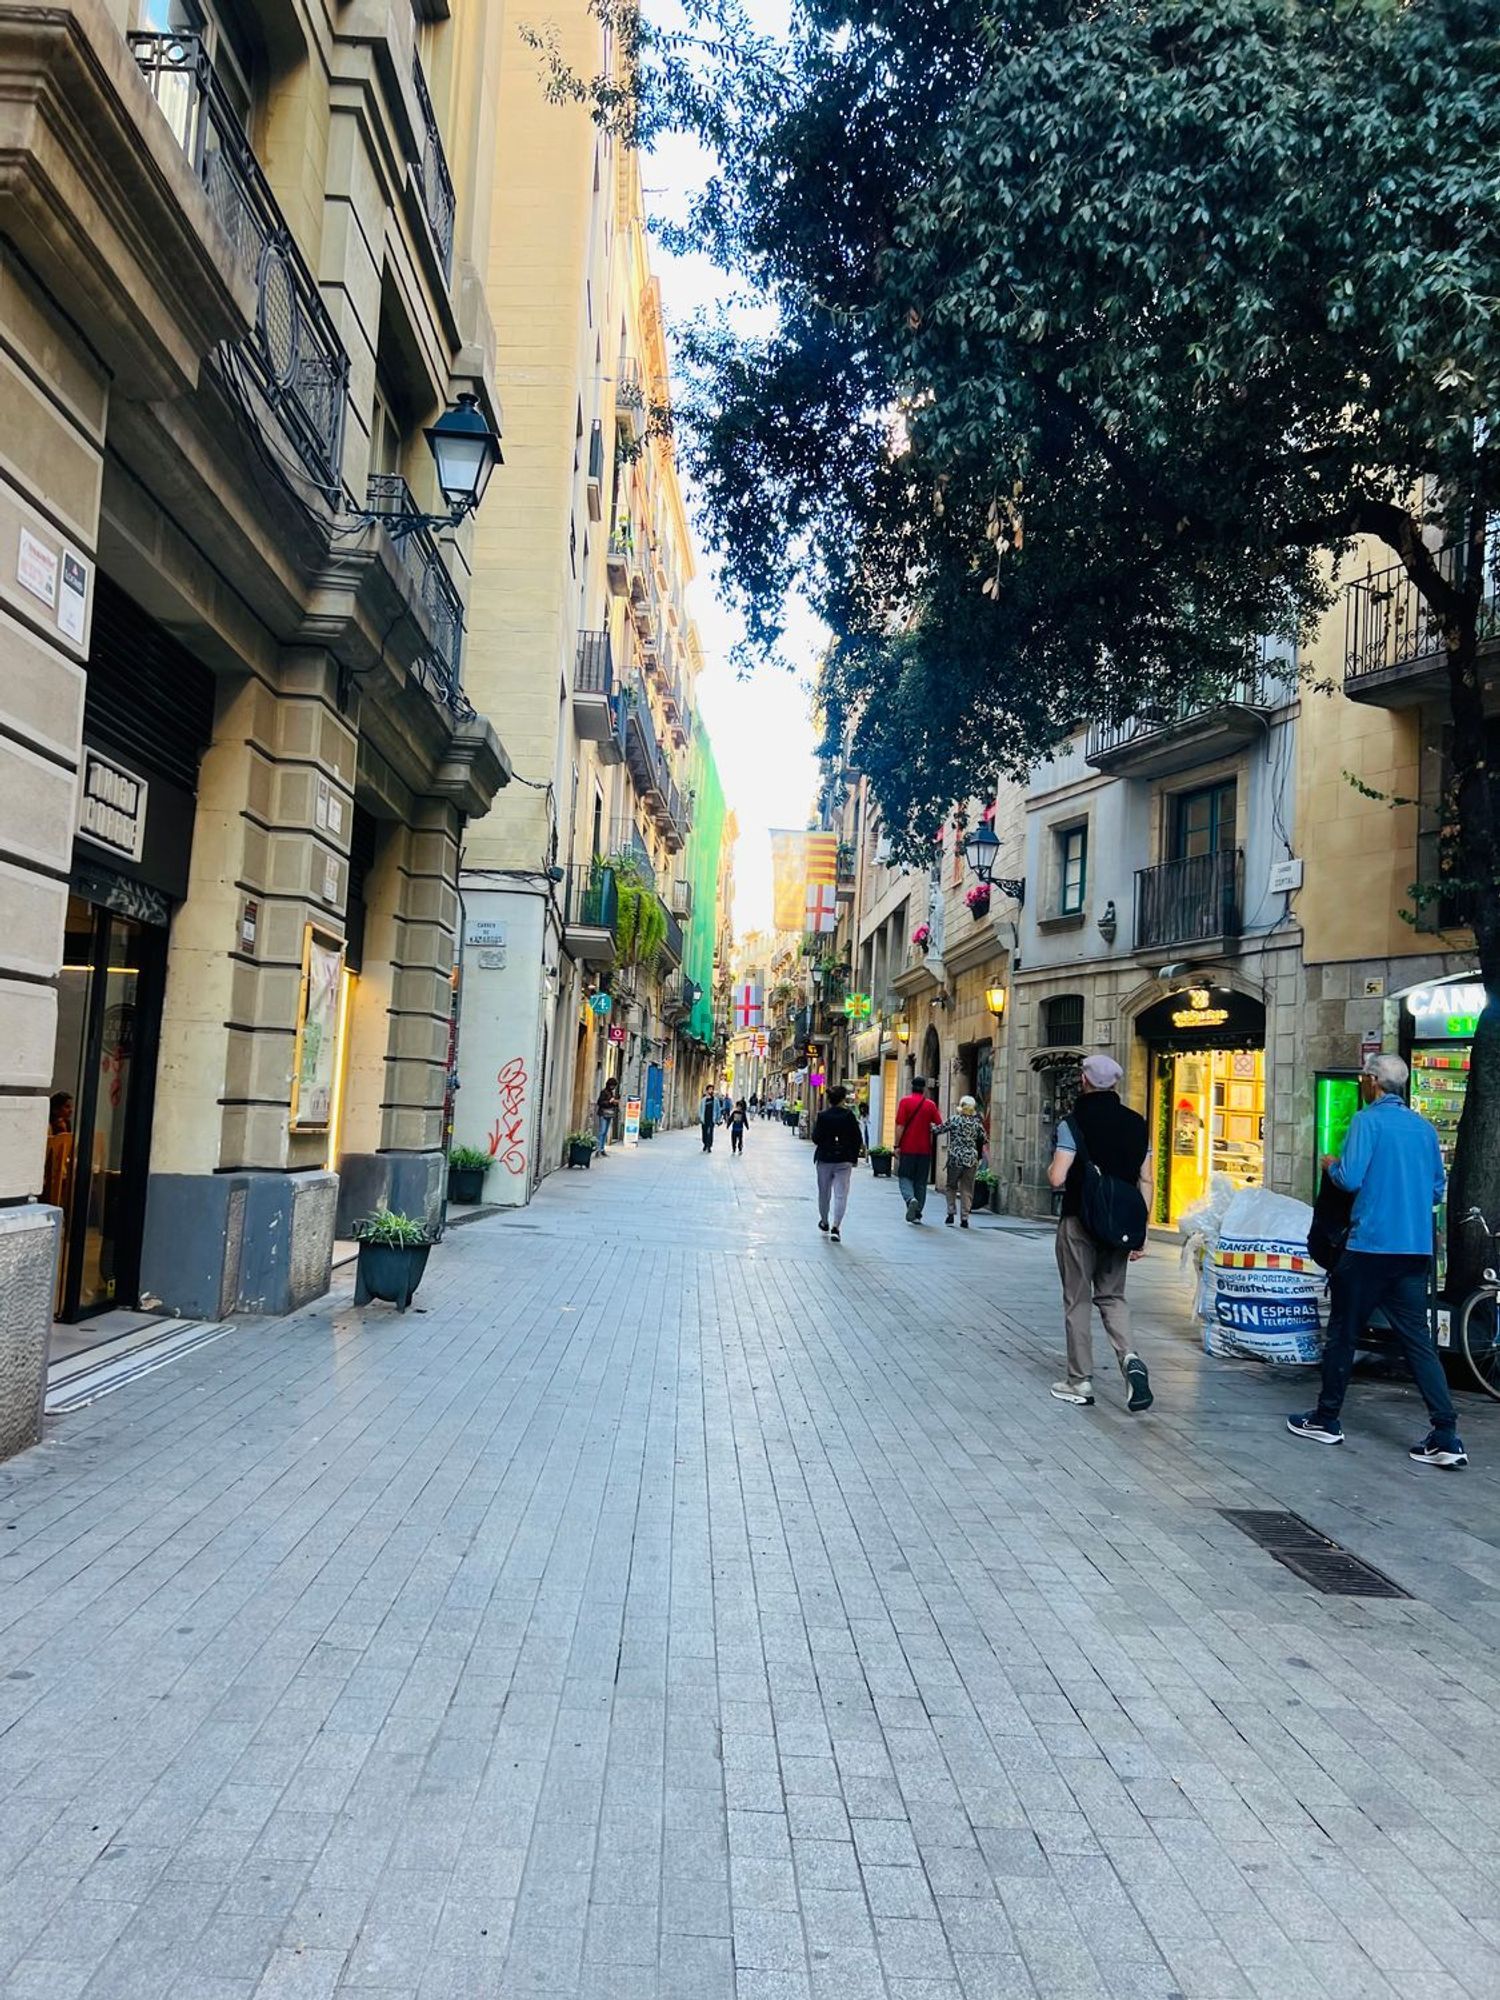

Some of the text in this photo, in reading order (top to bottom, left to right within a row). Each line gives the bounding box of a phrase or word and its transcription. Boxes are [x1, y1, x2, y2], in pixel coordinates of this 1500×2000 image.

[80, 796, 137, 849] COFFEE
[1217, 1302, 1316, 1326] SIN ESPERAS
